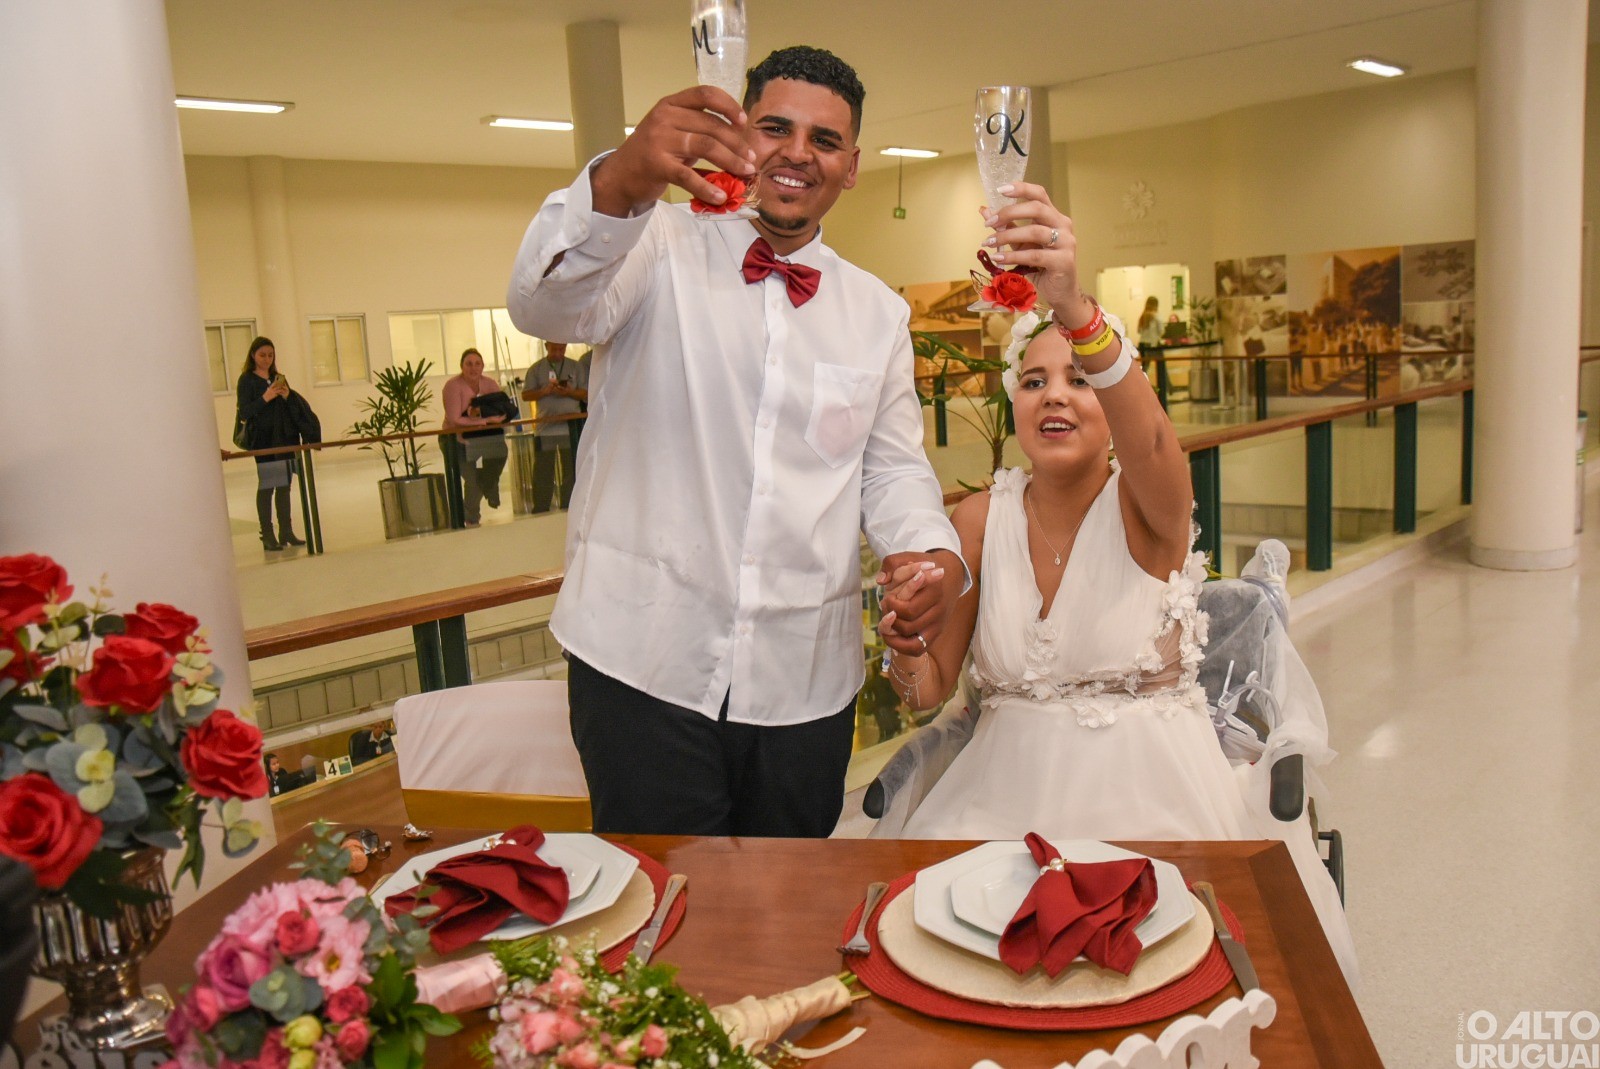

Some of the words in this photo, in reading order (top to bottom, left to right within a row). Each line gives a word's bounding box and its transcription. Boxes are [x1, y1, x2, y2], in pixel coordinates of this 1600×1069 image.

[691, 19, 718, 70] M
[986, 109, 1028, 157] K
[328, 762, 338, 776] 4
